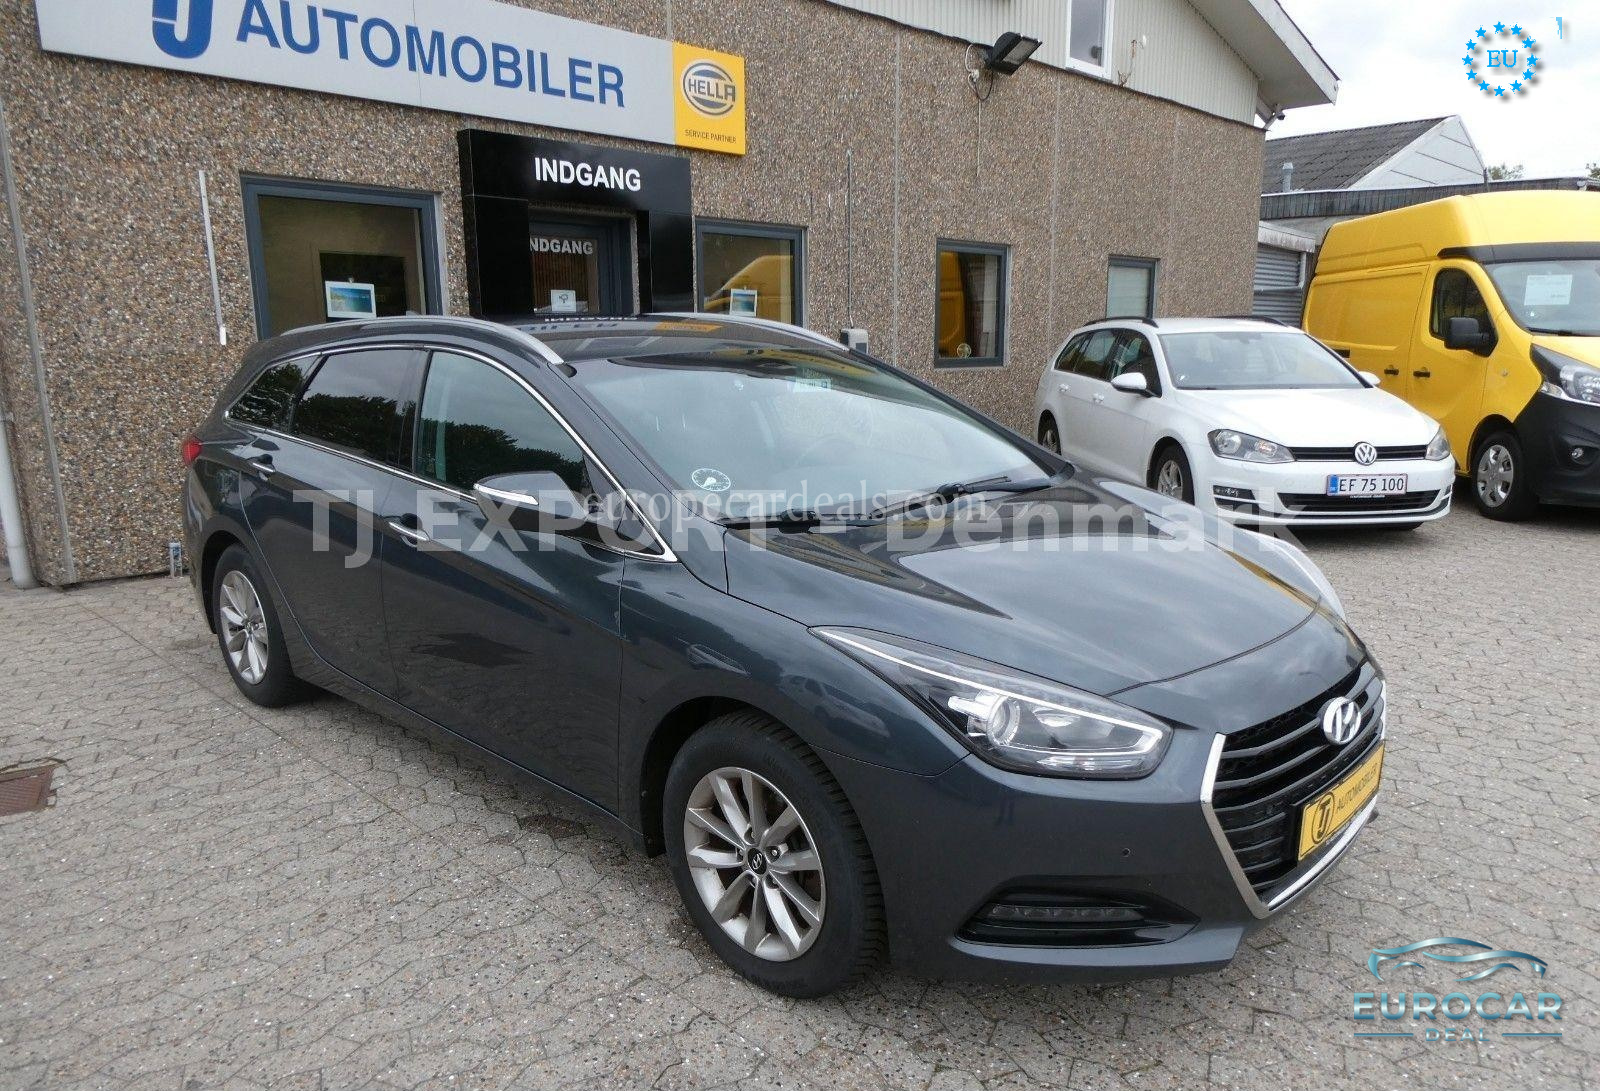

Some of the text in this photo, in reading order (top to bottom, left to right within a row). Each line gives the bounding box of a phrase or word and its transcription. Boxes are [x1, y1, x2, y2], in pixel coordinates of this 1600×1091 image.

[236, 0, 625, 108] AUTOMOBILER
[688, 78, 736, 103] HELLA
[685, 129, 737, 144] SERVICE PARTNER
[534, 157, 641, 192] INDGANG
[529, 235, 593, 255] NDGANG
[1339, 477, 1405, 492] EF 75 100
